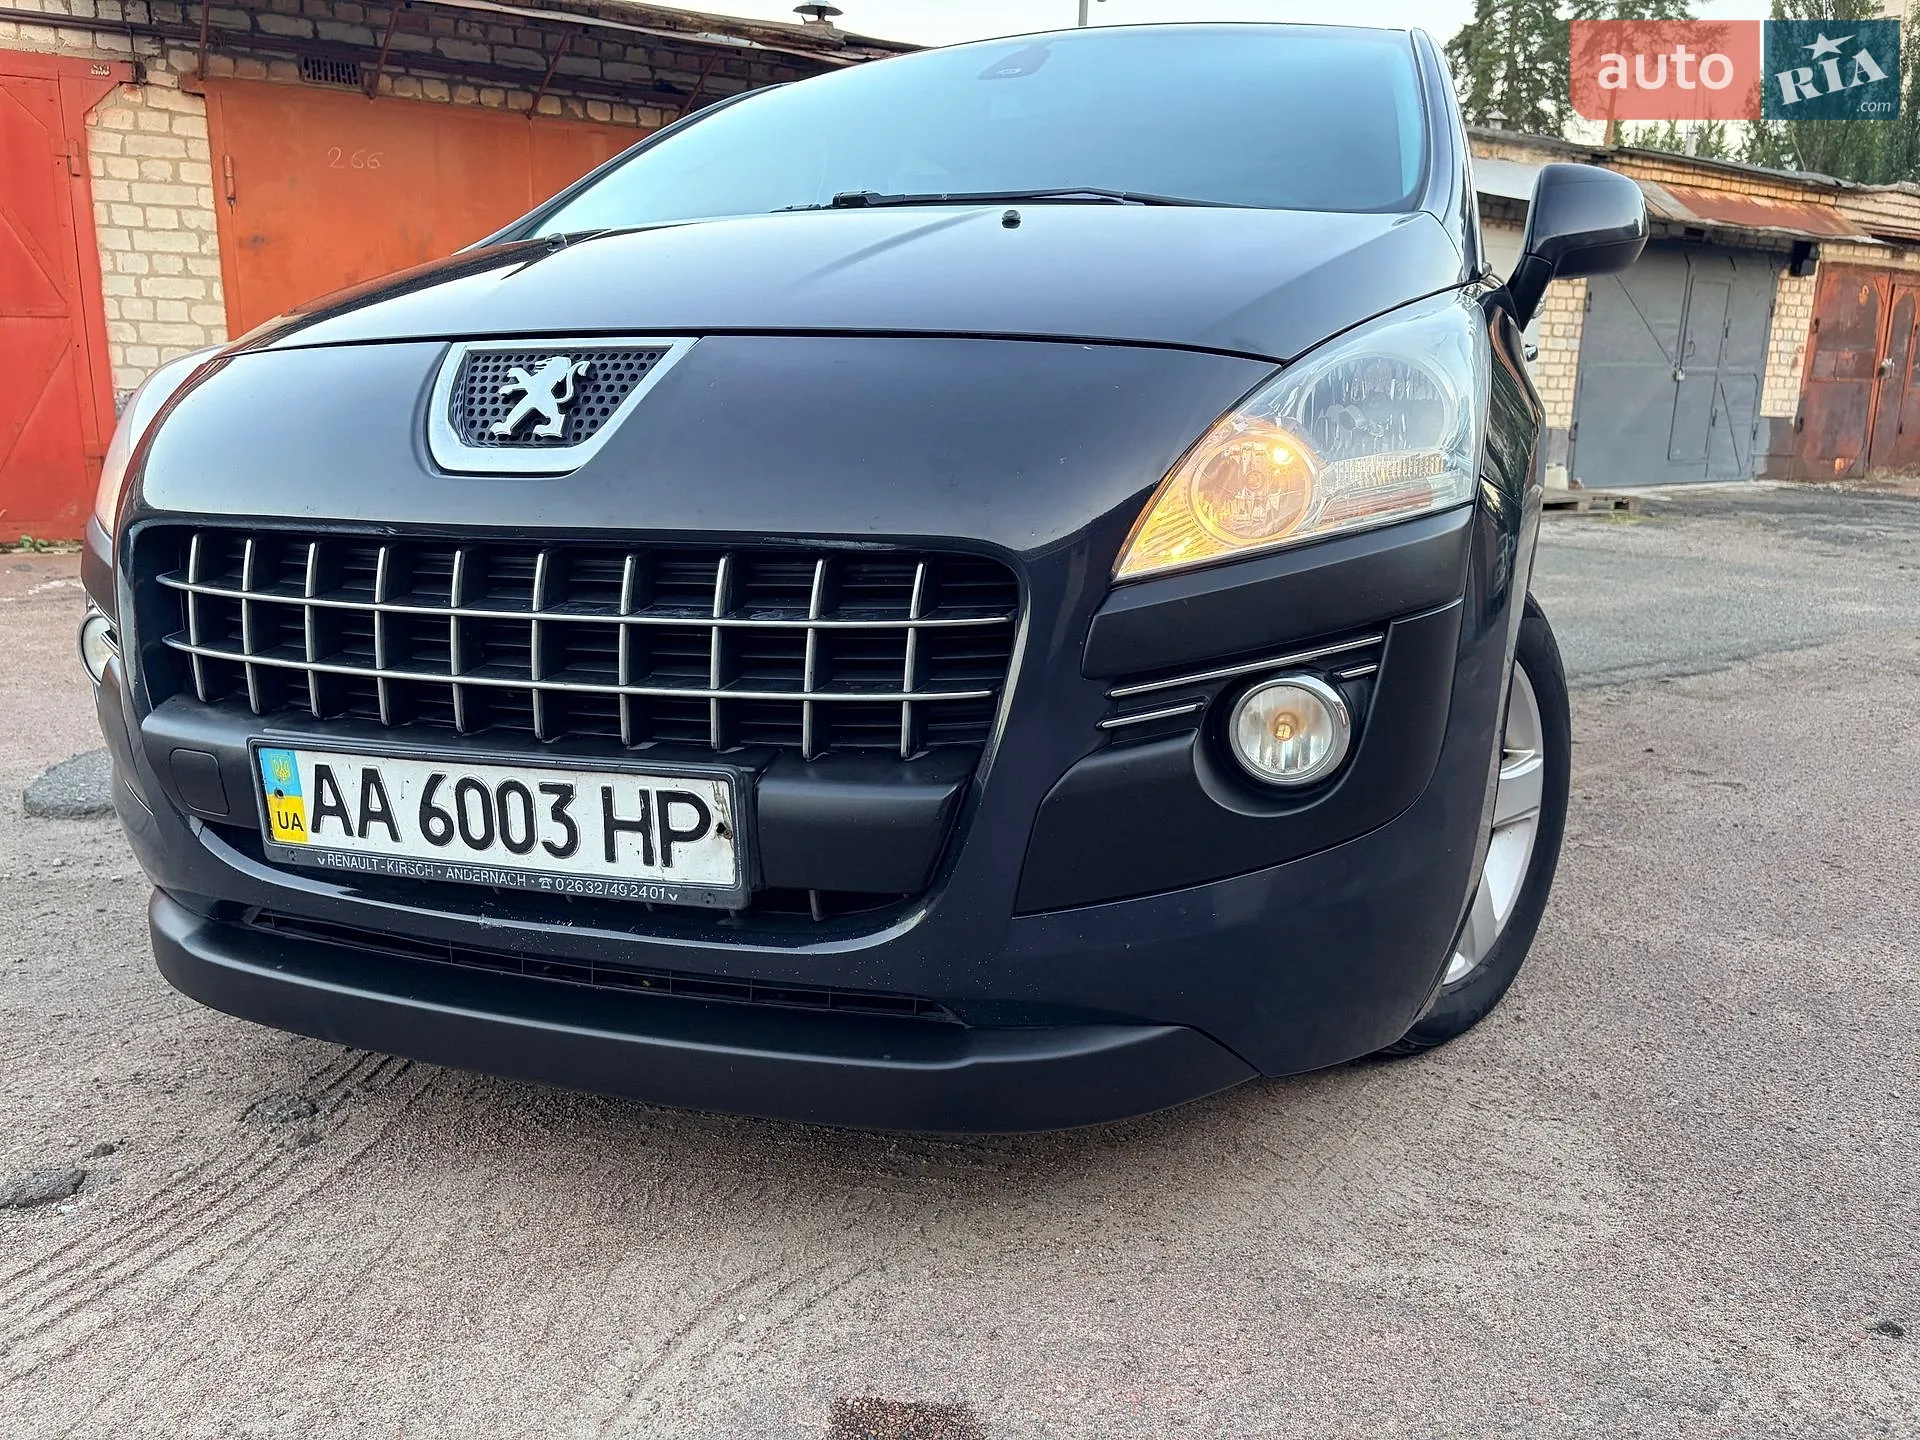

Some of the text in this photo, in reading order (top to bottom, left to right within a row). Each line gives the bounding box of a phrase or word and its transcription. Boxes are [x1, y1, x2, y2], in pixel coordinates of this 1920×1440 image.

[327, 146, 383, 169] 266
[276, 810, 305, 832] UA
[311, 763, 712, 868] AA 6003 HP
[445, 867, 526, 887] ANDERNACH
